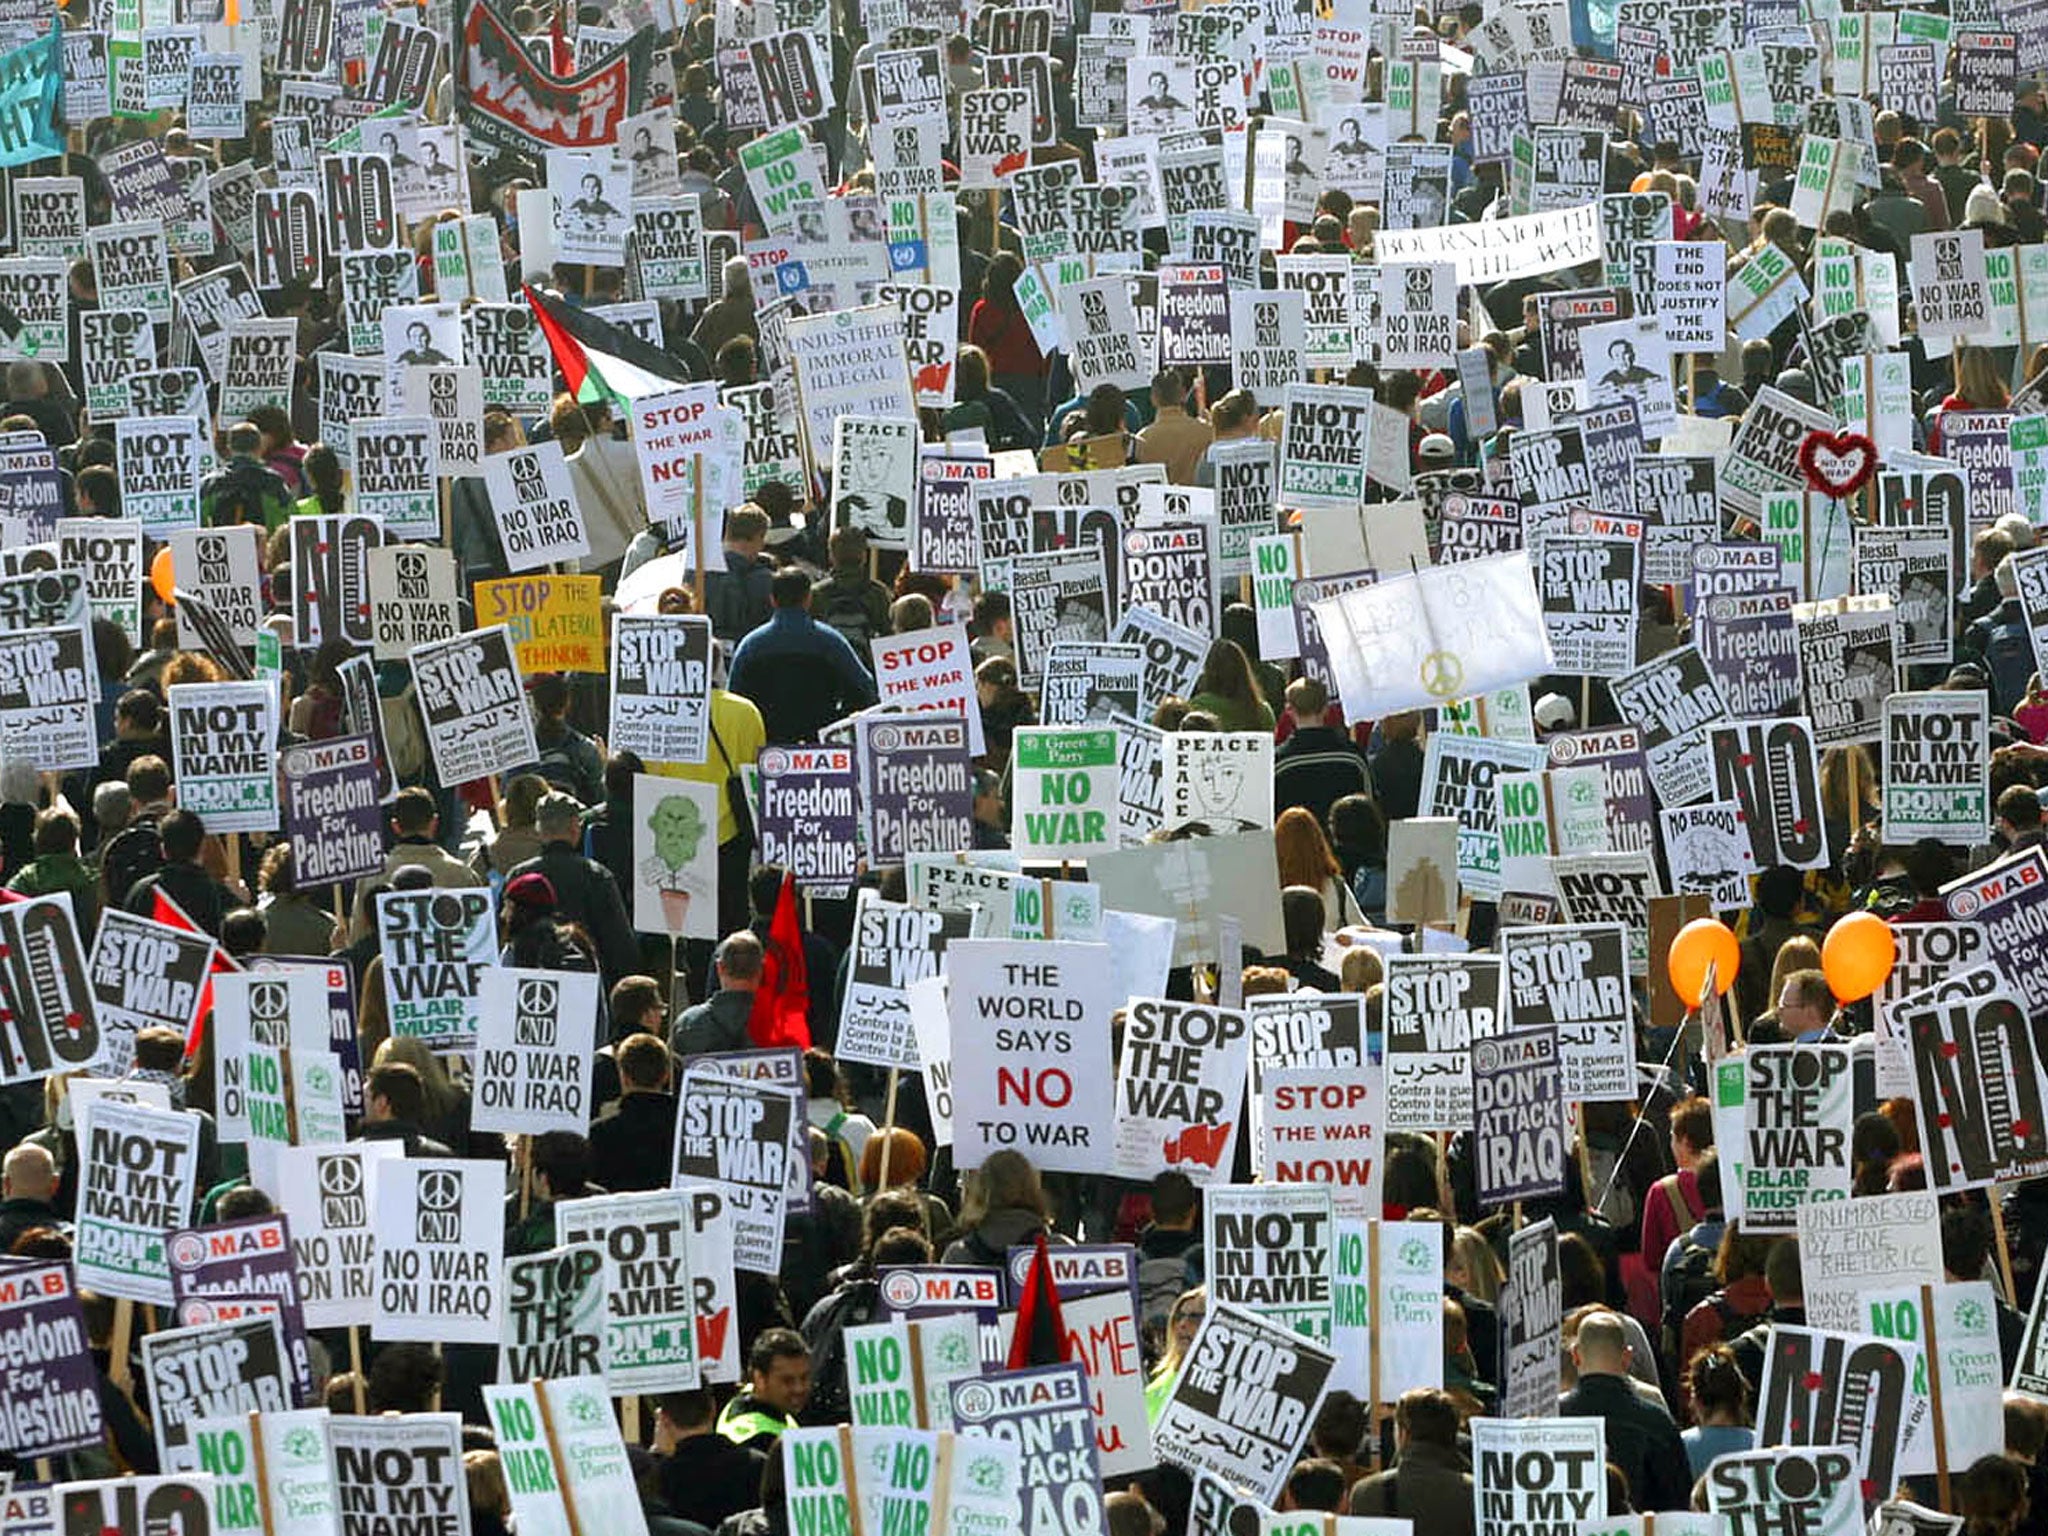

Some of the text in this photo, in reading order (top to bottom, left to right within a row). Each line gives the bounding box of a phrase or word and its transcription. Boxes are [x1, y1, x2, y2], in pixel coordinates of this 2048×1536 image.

[1978, 34, 2016, 49] MAB
[1959, 55, 2015, 76] Freedom
[1976, 76, 1996, 86] For
[964, 93, 1024, 113] STOP
[1957, 86, 2015, 113] Palestine
[965, 116, 1006, 134] THE
[964, 136, 1022, 154] WAR
[326, 158, 394, 250] NO
[1071, 186, 1137, 211] STOP
[1074, 211, 1122, 230] THE
[98, 238, 158, 258] NOT
[258, 191, 320, 288] NO
[1073, 232, 1138, 252] WAR
[100, 257, 160, 275] IN MY
[1675, 249, 1703, 260] THE
[102, 270, 163, 288] NAME
[345, 256, 410, 280] STOP
[1179, 268, 1221, 281] MAB
[1675, 263, 1704, 275] END
[349, 278, 397, 299] THE
[1657, 280, 1721, 292] DOES NOT
[1920, 284, 1981, 303] NO WAR
[1163, 292, 1226, 317] Freedom
[1660, 299, 1719, 311] JUSTIFY
[1922, 303, 1983, 321] ON IRAQ
[1186, 317, 1209, 330] For
[1387, 316, 1450, 333] NO WAR
[1674, 315, 1703, 326] THE
[1165, 328, 1230, 359] Palestine
[1387, 336, 1451, 353] ON IRAQ
[1665, 330, 1713, 341] MEANS
[808, 344, 900, 371] IMMORAL
[811, 368, 893, 392] ILLEGAL
[1290, 402, 1365, 426] NOT
[842, 423, 906, 438] PEACE
[1289, 427, 1360, 447] IN MY
[1286, 444, 1361, 464] NAME
[1821, 459, 1856, 468] NO TO
[1284, 466, 1362, 486] DON'T
[1153, 532, 1199, 550] MAB
[1128, 556, 1207, 580] DON'T
[293, 518, 380, 642] NO
[398, 577, 429, 597] CND
[1130, 577, 1207, 601] ATTACK
[378, 602, 450, 620] NO WAR
[493, 581, 589, 618] STOP THE
[379, 623, 453, 642] ON IRAQ
[1850, 624, 1890, 645] Revolt
[620, 629, 685, 663] STOP
[1801, 636, 1848, 660] STOP
[1048, 657, 1087, 673] Resist
[621, 660, 704, 694] THE WAR
[1098, 672, 1138, 690] Revolt
[179, 704, 265, 734] NOT
[1813, 704, 1854, 727] WAR
[1890, 714, 1978, 741] NOT
[180, 735, 264, 758] IN MY
[316, 746, 366, 766] MAB
[1178, 740, 1260, 752] PEACE
[1890, 742, 1980, 763] IN MY
[180, 756, 268, 774] NAME
[792, 755, 848, 772] MAB
[1889, 764, 1980, 783] NAME
[1040, 773, 1090, 803] NO
[1890, 788, 1982, 810] DON'T
[293, 782, 373, 818] Freedom
[766, 785, 851, 817] Freedom
[322, 816, 346, 831] For
[795, 820, 820, 835] For
[1026, 812, 1106, 844] WAR
[1669, 812, 1735, 836] NO BLOOD
[297, 831, 382, 876] Palestine
[764, 836, 855, 874] Palestine
[1718, 880, 1746, 902] OIL!
[1003, 965, 1059, 987] THE
[978, 1000, 1083, 1020] WORLD
[1130, 1004, 1244, 1050] STOP
[995, 1032, 1071, 1052] SAYS
[1502, 1039, 1554, 1065] MAB
[483, 1050, 580, 1081] NO WAR
[1129, 1040, 1198, 1083] THE
[1751, 1053, 1847, 1087] STOP
[482, 1080, 581, 1113] ON IRAQ
[997, 1068, 1073, 1108] NO
[1276, 1087, 1366, 1109] STOP
[1477, 1071, 1557, 1110] DON'T
[1126, 1079, 1223, 1125] WAR
[1753, 1091, 1818, 1126] THE
[1274, 1125, 1370, 1142] THE WAR
[1477, 1107, 1560, 1137] ATTACK
[978, 1123, 1089, 1146] TO WAR
[92, 1128, 187, 1176] NOT
[1749, 1130, 1845, 1167] WAR
[1277, 1161, 1370, 1184] NOW
[1479, 1139, 1565, 1190] IRAQ
[88, 1168, 183, 1202] IN MY
[1747, 1169, 1808, 1187] BLAIR
[1747, 1190, 1803, 1206] MUST
[85, 1194, 181, 1227] NAME
[1216, 1214, 1327, 1248] NOT
[1844, 1229, 1890, 1252] FINE
[1217, 1251, 1326, 1275] IN MY
[1339, 1234, 1361, 1274] NO
[384, 1250, 489, 1282] NO WAR
[382, 1284, 491, 1319] ON IRAQ
[1216, 1277, 1328, 1303] NAME
[1336, 1284, 1367, 1328] WAR
[1871, 1301, 1917, 1341] NO
[1199, 1327, 1297, 1388] STOP
[1950, 1351, 1996, 1370] Green
[1190, 1364, 1222, 1395] THE
[1954, 1368, 1994, 1386] Party
[1219, 1379, 1304, 1446] WAR
